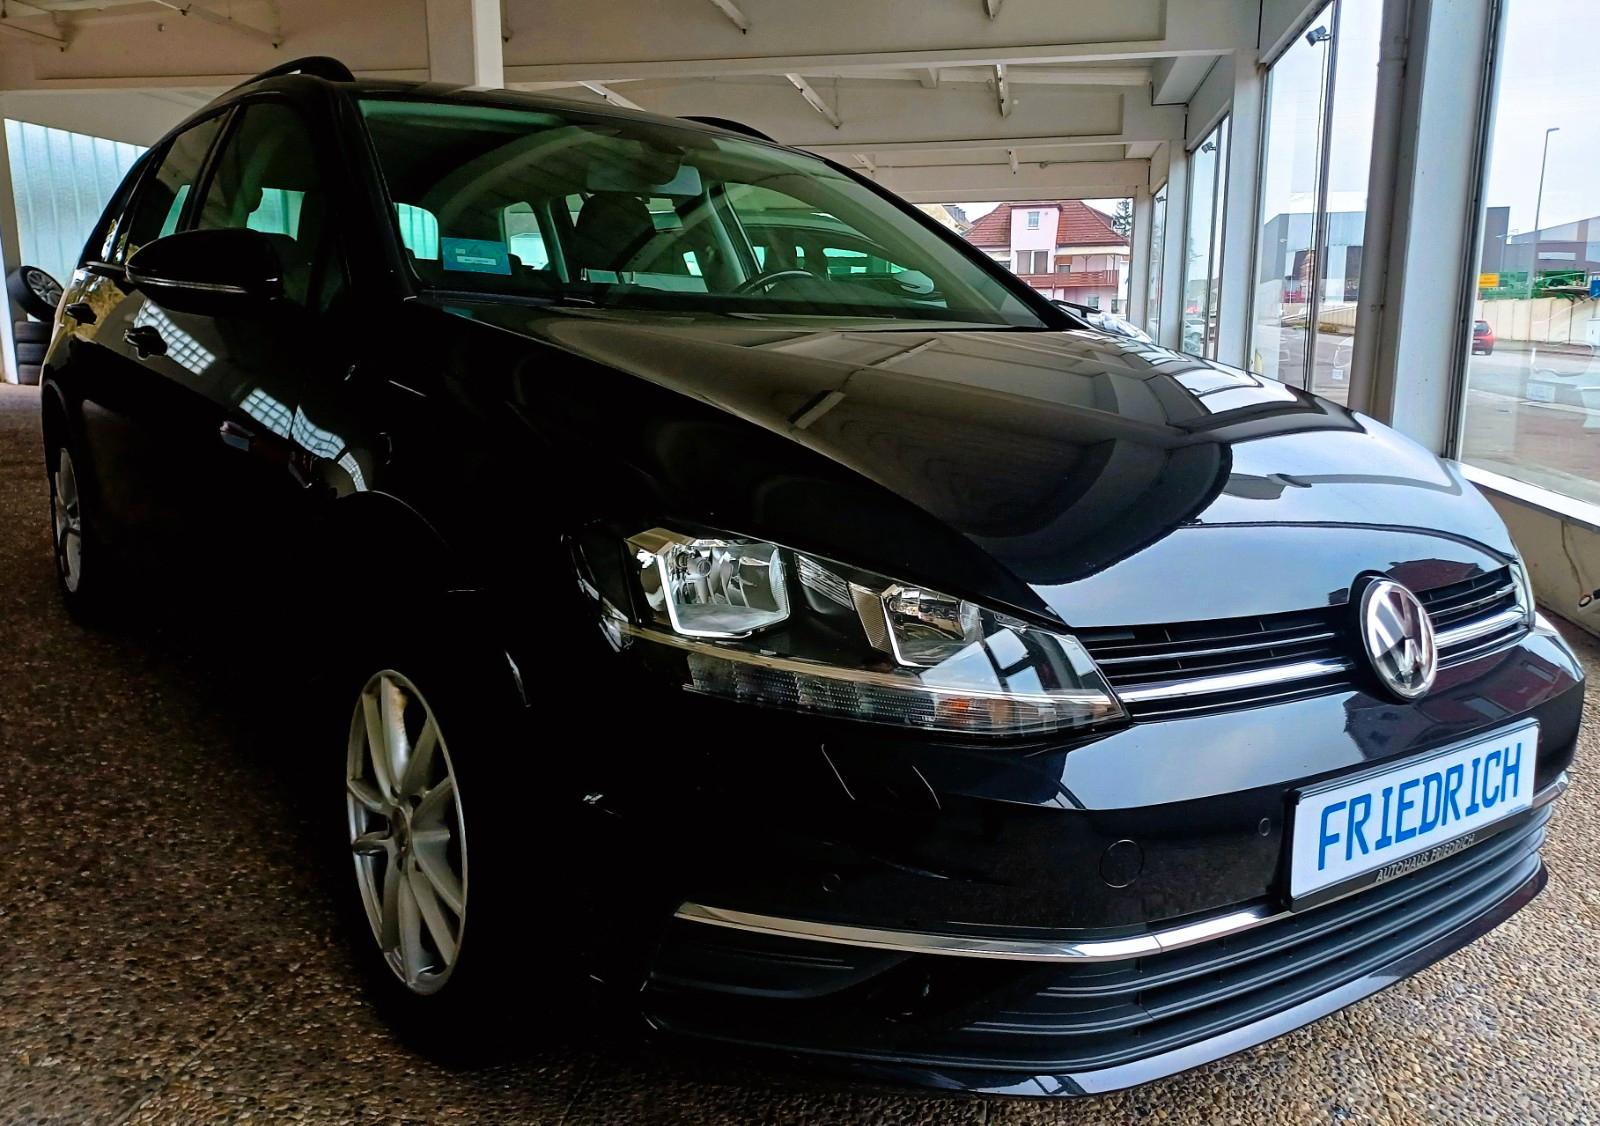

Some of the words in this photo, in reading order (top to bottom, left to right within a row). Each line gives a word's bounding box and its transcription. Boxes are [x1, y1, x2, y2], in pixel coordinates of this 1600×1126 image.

[1363, 579, 1435, 697] VW
[1317, 742, 1523, 872] FRIEDRICH
[1375, 851, 1430, 883] AUTOHAUS
[1430, 833, 1476, 862] FRIEDRICH
